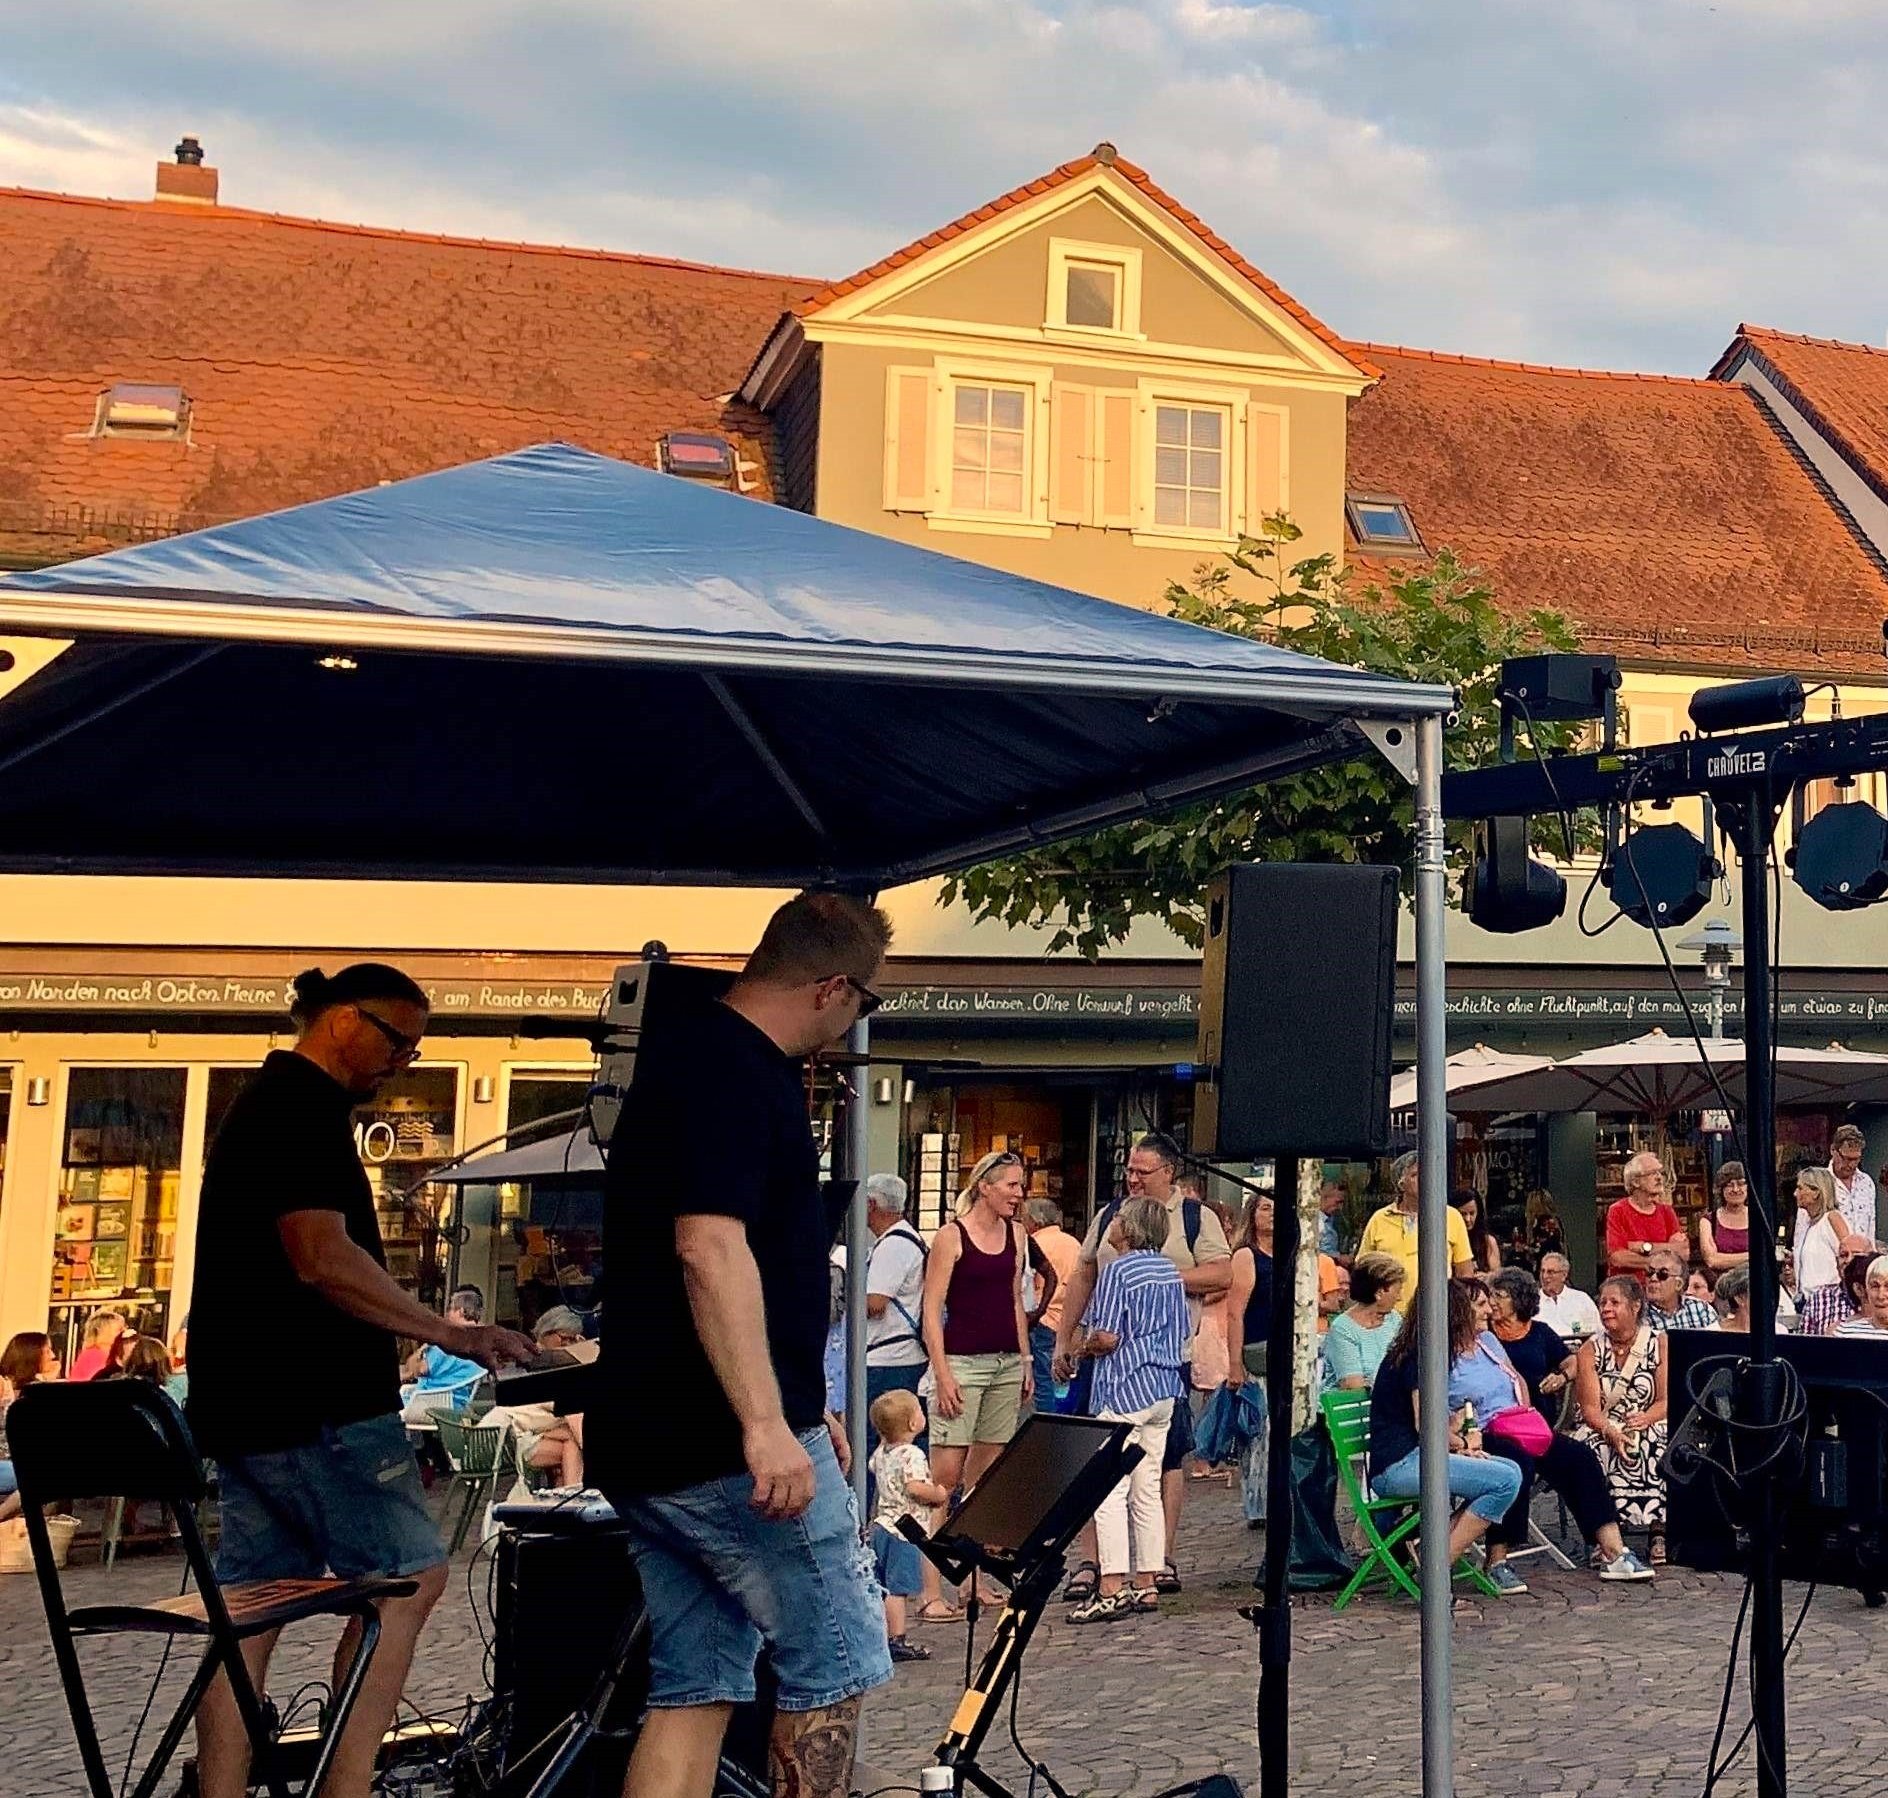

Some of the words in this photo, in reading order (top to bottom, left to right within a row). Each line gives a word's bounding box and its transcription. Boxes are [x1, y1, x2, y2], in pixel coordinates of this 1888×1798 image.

[1707, 753, 1751, 778] CHAUVET
[0, 986, 21, 1000] on
[26, 979, 98, 1001] Norden
[104, 980, 152, 1002] nach
[224, 982, 276, 1003] Meine
[444, 990, 470, 1007] am
[480, 986, 533, 1008] Rande
[537, 989, 567, 1009] des
[936, 992, 969, 1011] das
[1032, 993, 1070, 1012] Ohne
[1077, 993, 1133, 1016] Vorwurf
[1139, 994, 1192, 1017] vergeht
[1444, 996, 1501, 1013] eschichte
[1506, 996, 1533, 1013] ohne
[1539, 996, 1613, 1018] Fluchtpunkt,
[1612, 996, 1635, 1019] auf
[1638, 997, 1659, 1013] den
[1780, 1003, 1797, 1014] um
[1803, 997, 1842, 1014] etwas
[1848, 1003, 1864, 1015] zu
